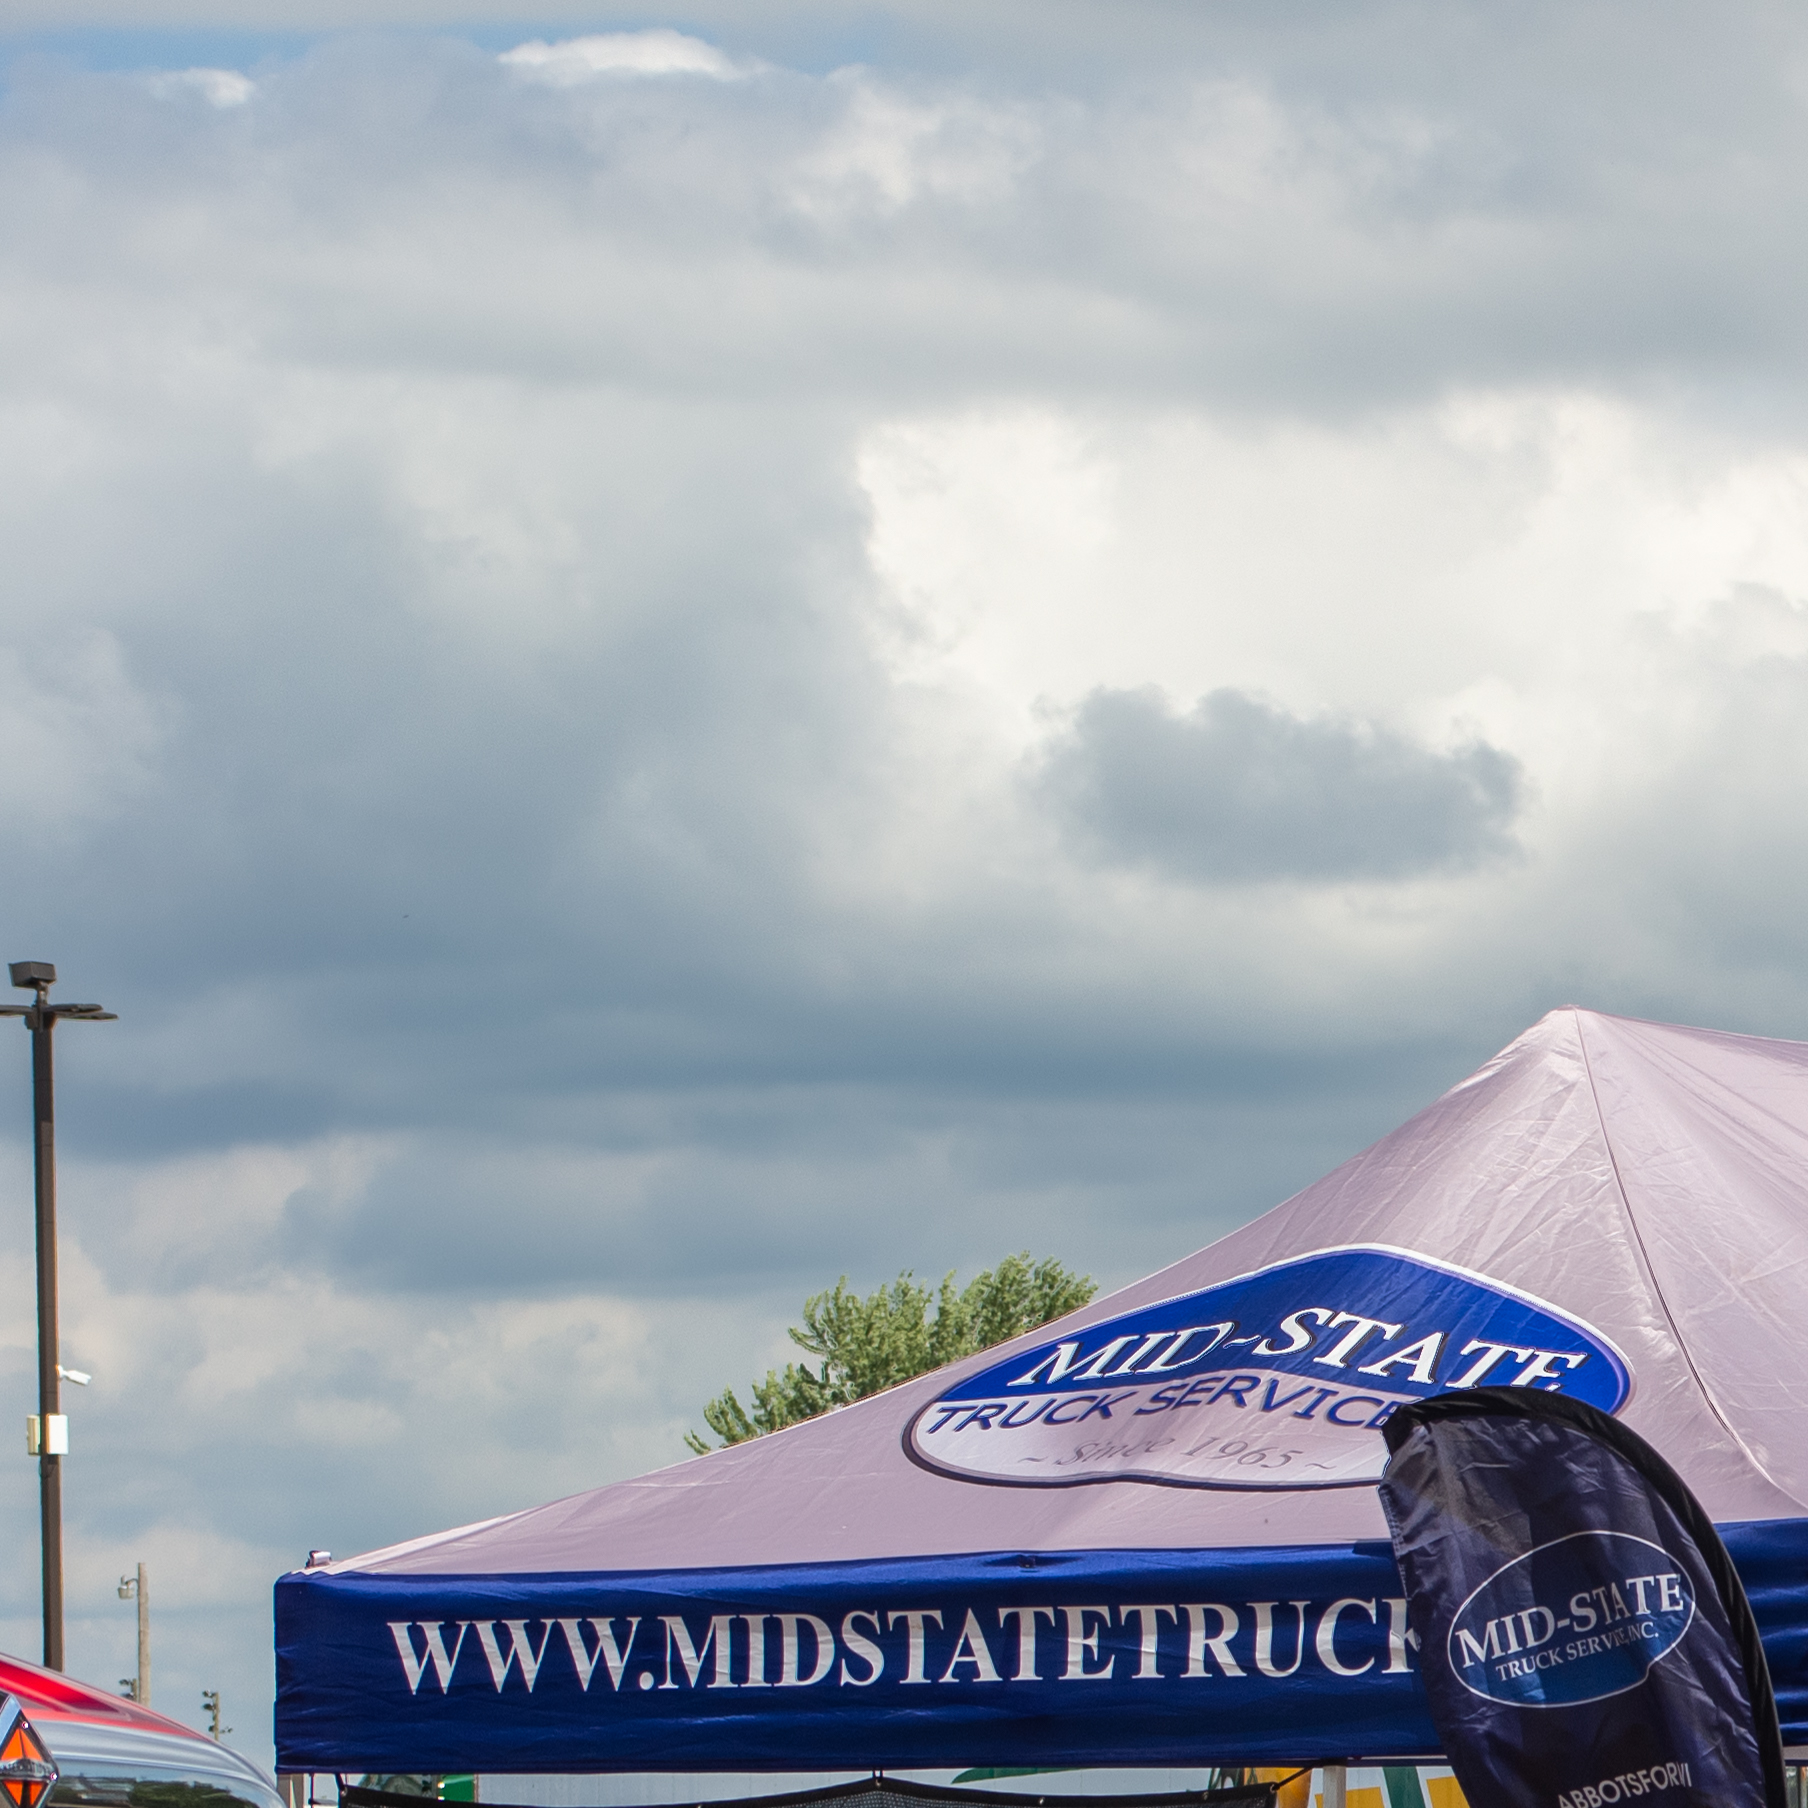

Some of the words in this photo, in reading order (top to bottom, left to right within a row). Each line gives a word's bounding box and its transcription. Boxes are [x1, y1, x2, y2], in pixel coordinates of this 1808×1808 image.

[926, 1391, 1134, 1435] TRUCK
[1056, 1437, 1176, 1467] Since
[1186, 1438, 1305, 1470] 1965
[1455, 1573, 1684, 1669] MID-STATE
[1496, 1649, 1564, 1681] TRUCK
